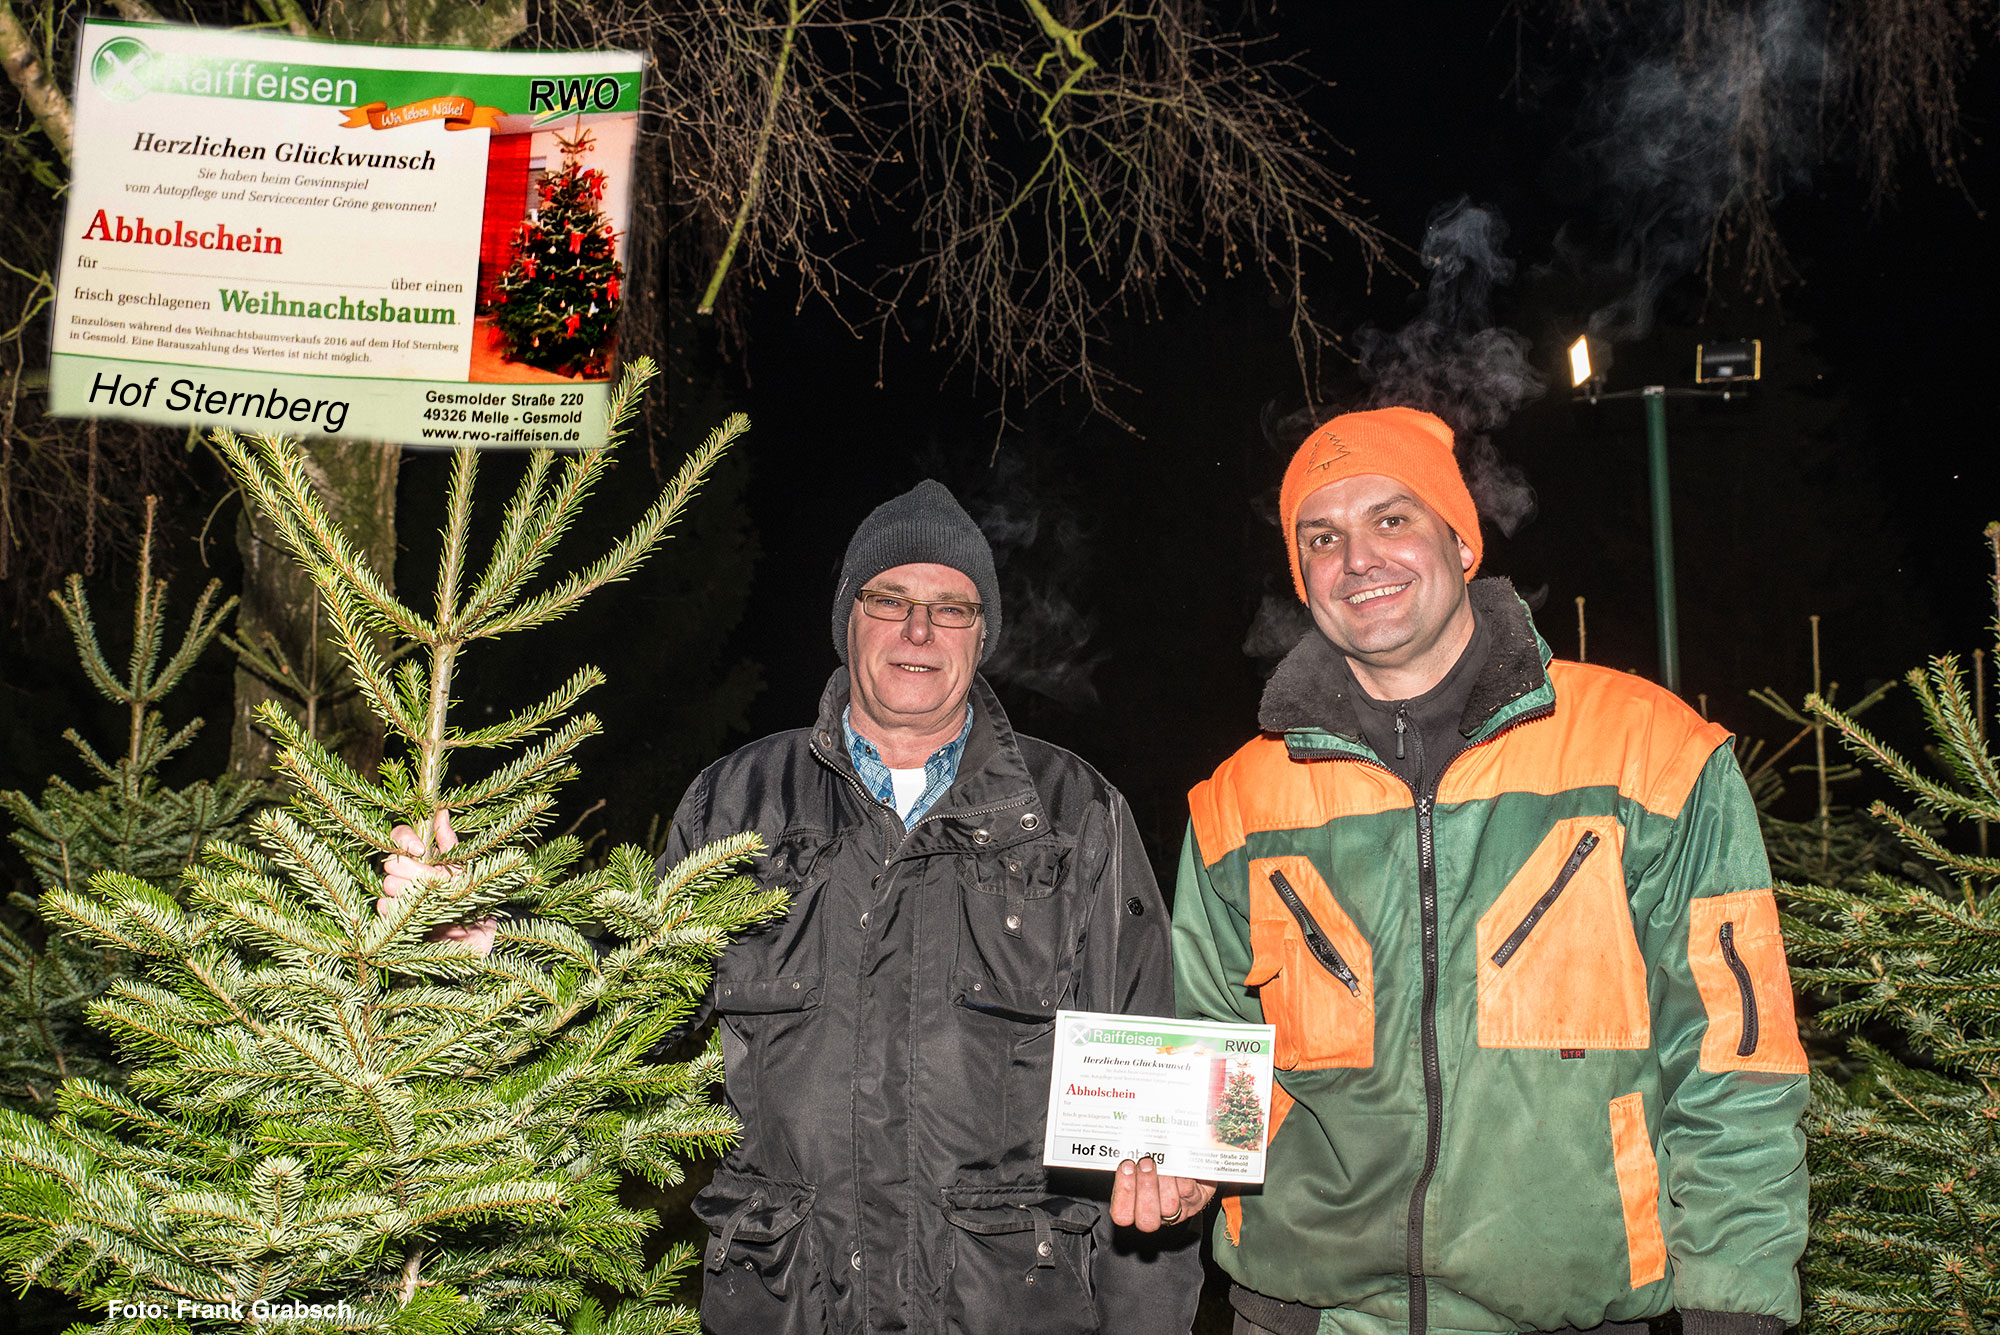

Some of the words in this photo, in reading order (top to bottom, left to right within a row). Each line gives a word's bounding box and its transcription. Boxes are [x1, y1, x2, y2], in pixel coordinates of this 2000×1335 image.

[1093, 1029, 1163, 1046] Raiffeisen
[1225, 1040, 1261, 1053] RWO
[1083, 1056, 1130, 1066] Herzlichen
[1132, 1058, 1191, 1071] Glückwunsch
[1066, 1083, 1136, 1099] Abholschein
[1072, 1143, 1096, 1156] Hof
[1099, 1145, 1165, 1164] Stenberg
